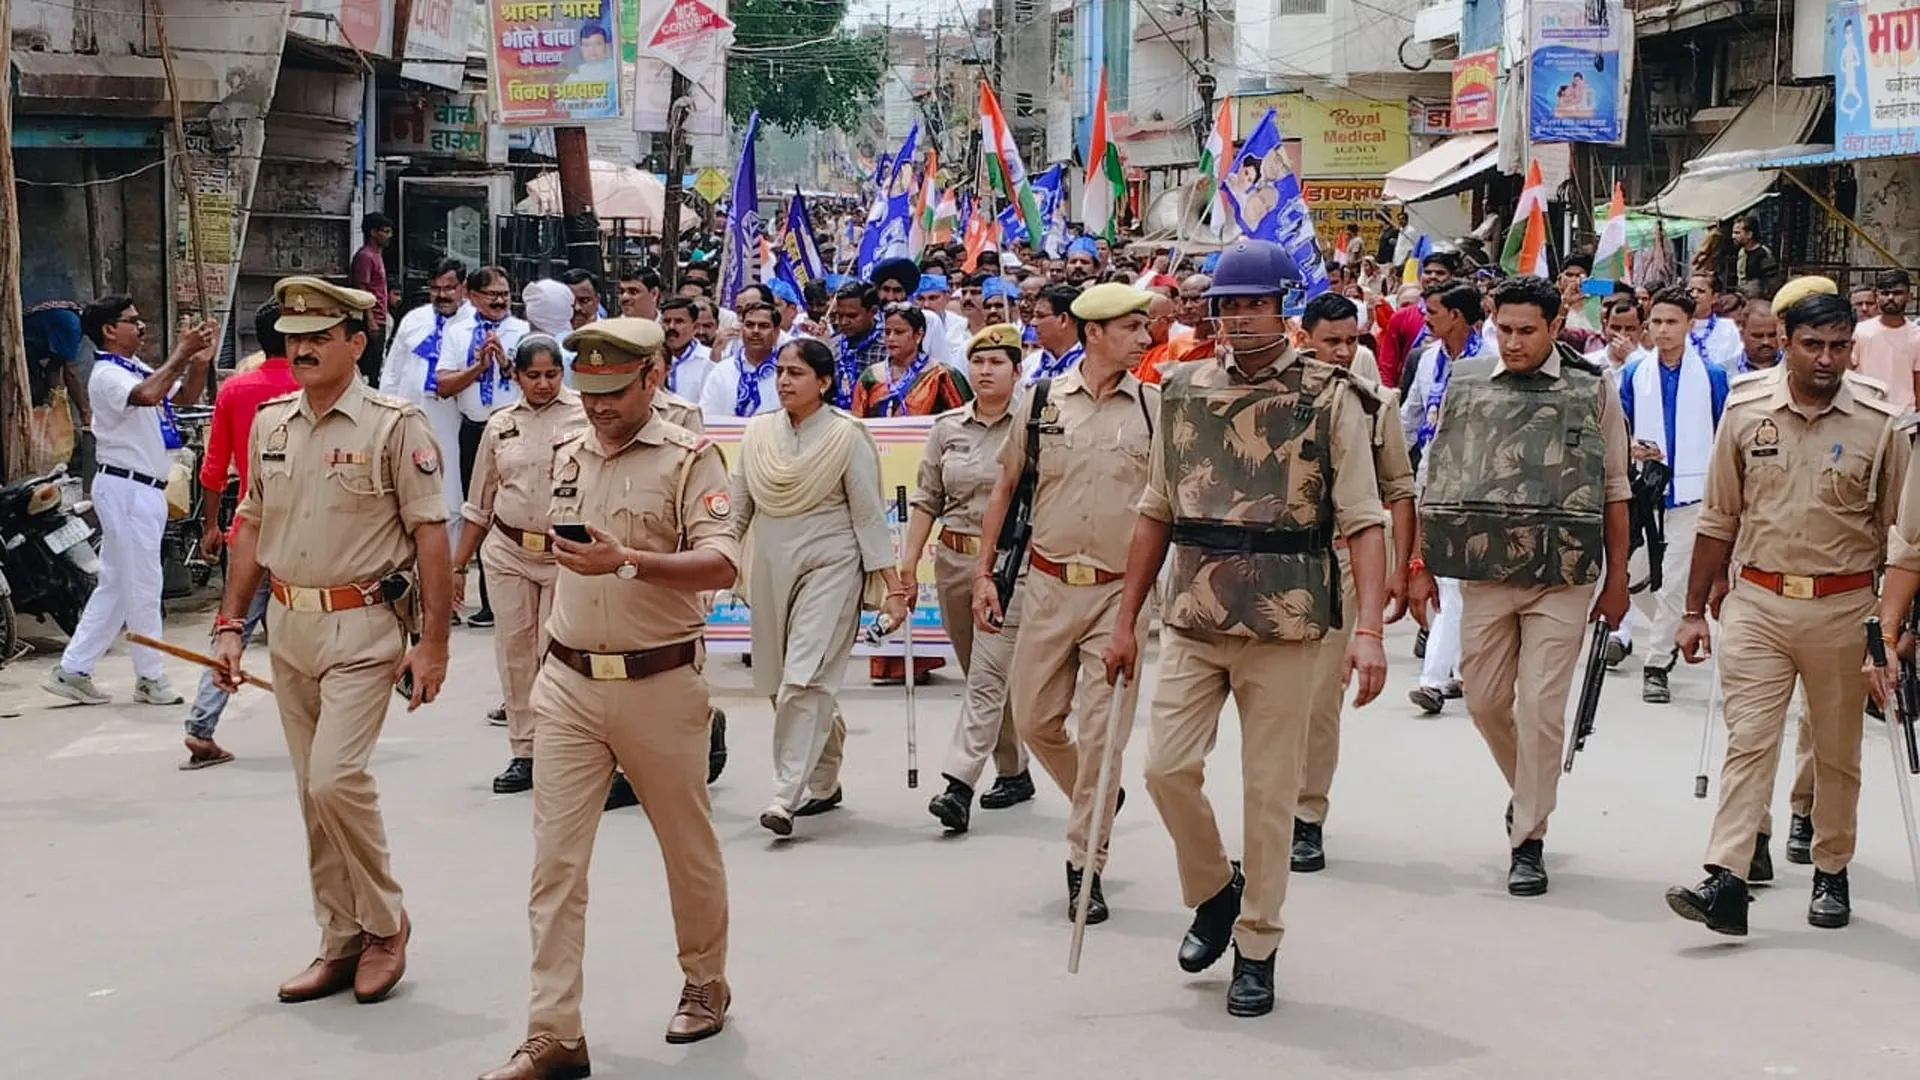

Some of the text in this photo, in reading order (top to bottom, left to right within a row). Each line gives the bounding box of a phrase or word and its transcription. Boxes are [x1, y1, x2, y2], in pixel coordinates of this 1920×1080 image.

[661, 13, 713, 35] CONVENT
[508, 80, 549, 101] विनय
[1329, 108, 1380, 128] Royal
[1323, 129, 1386, 144] Medical
